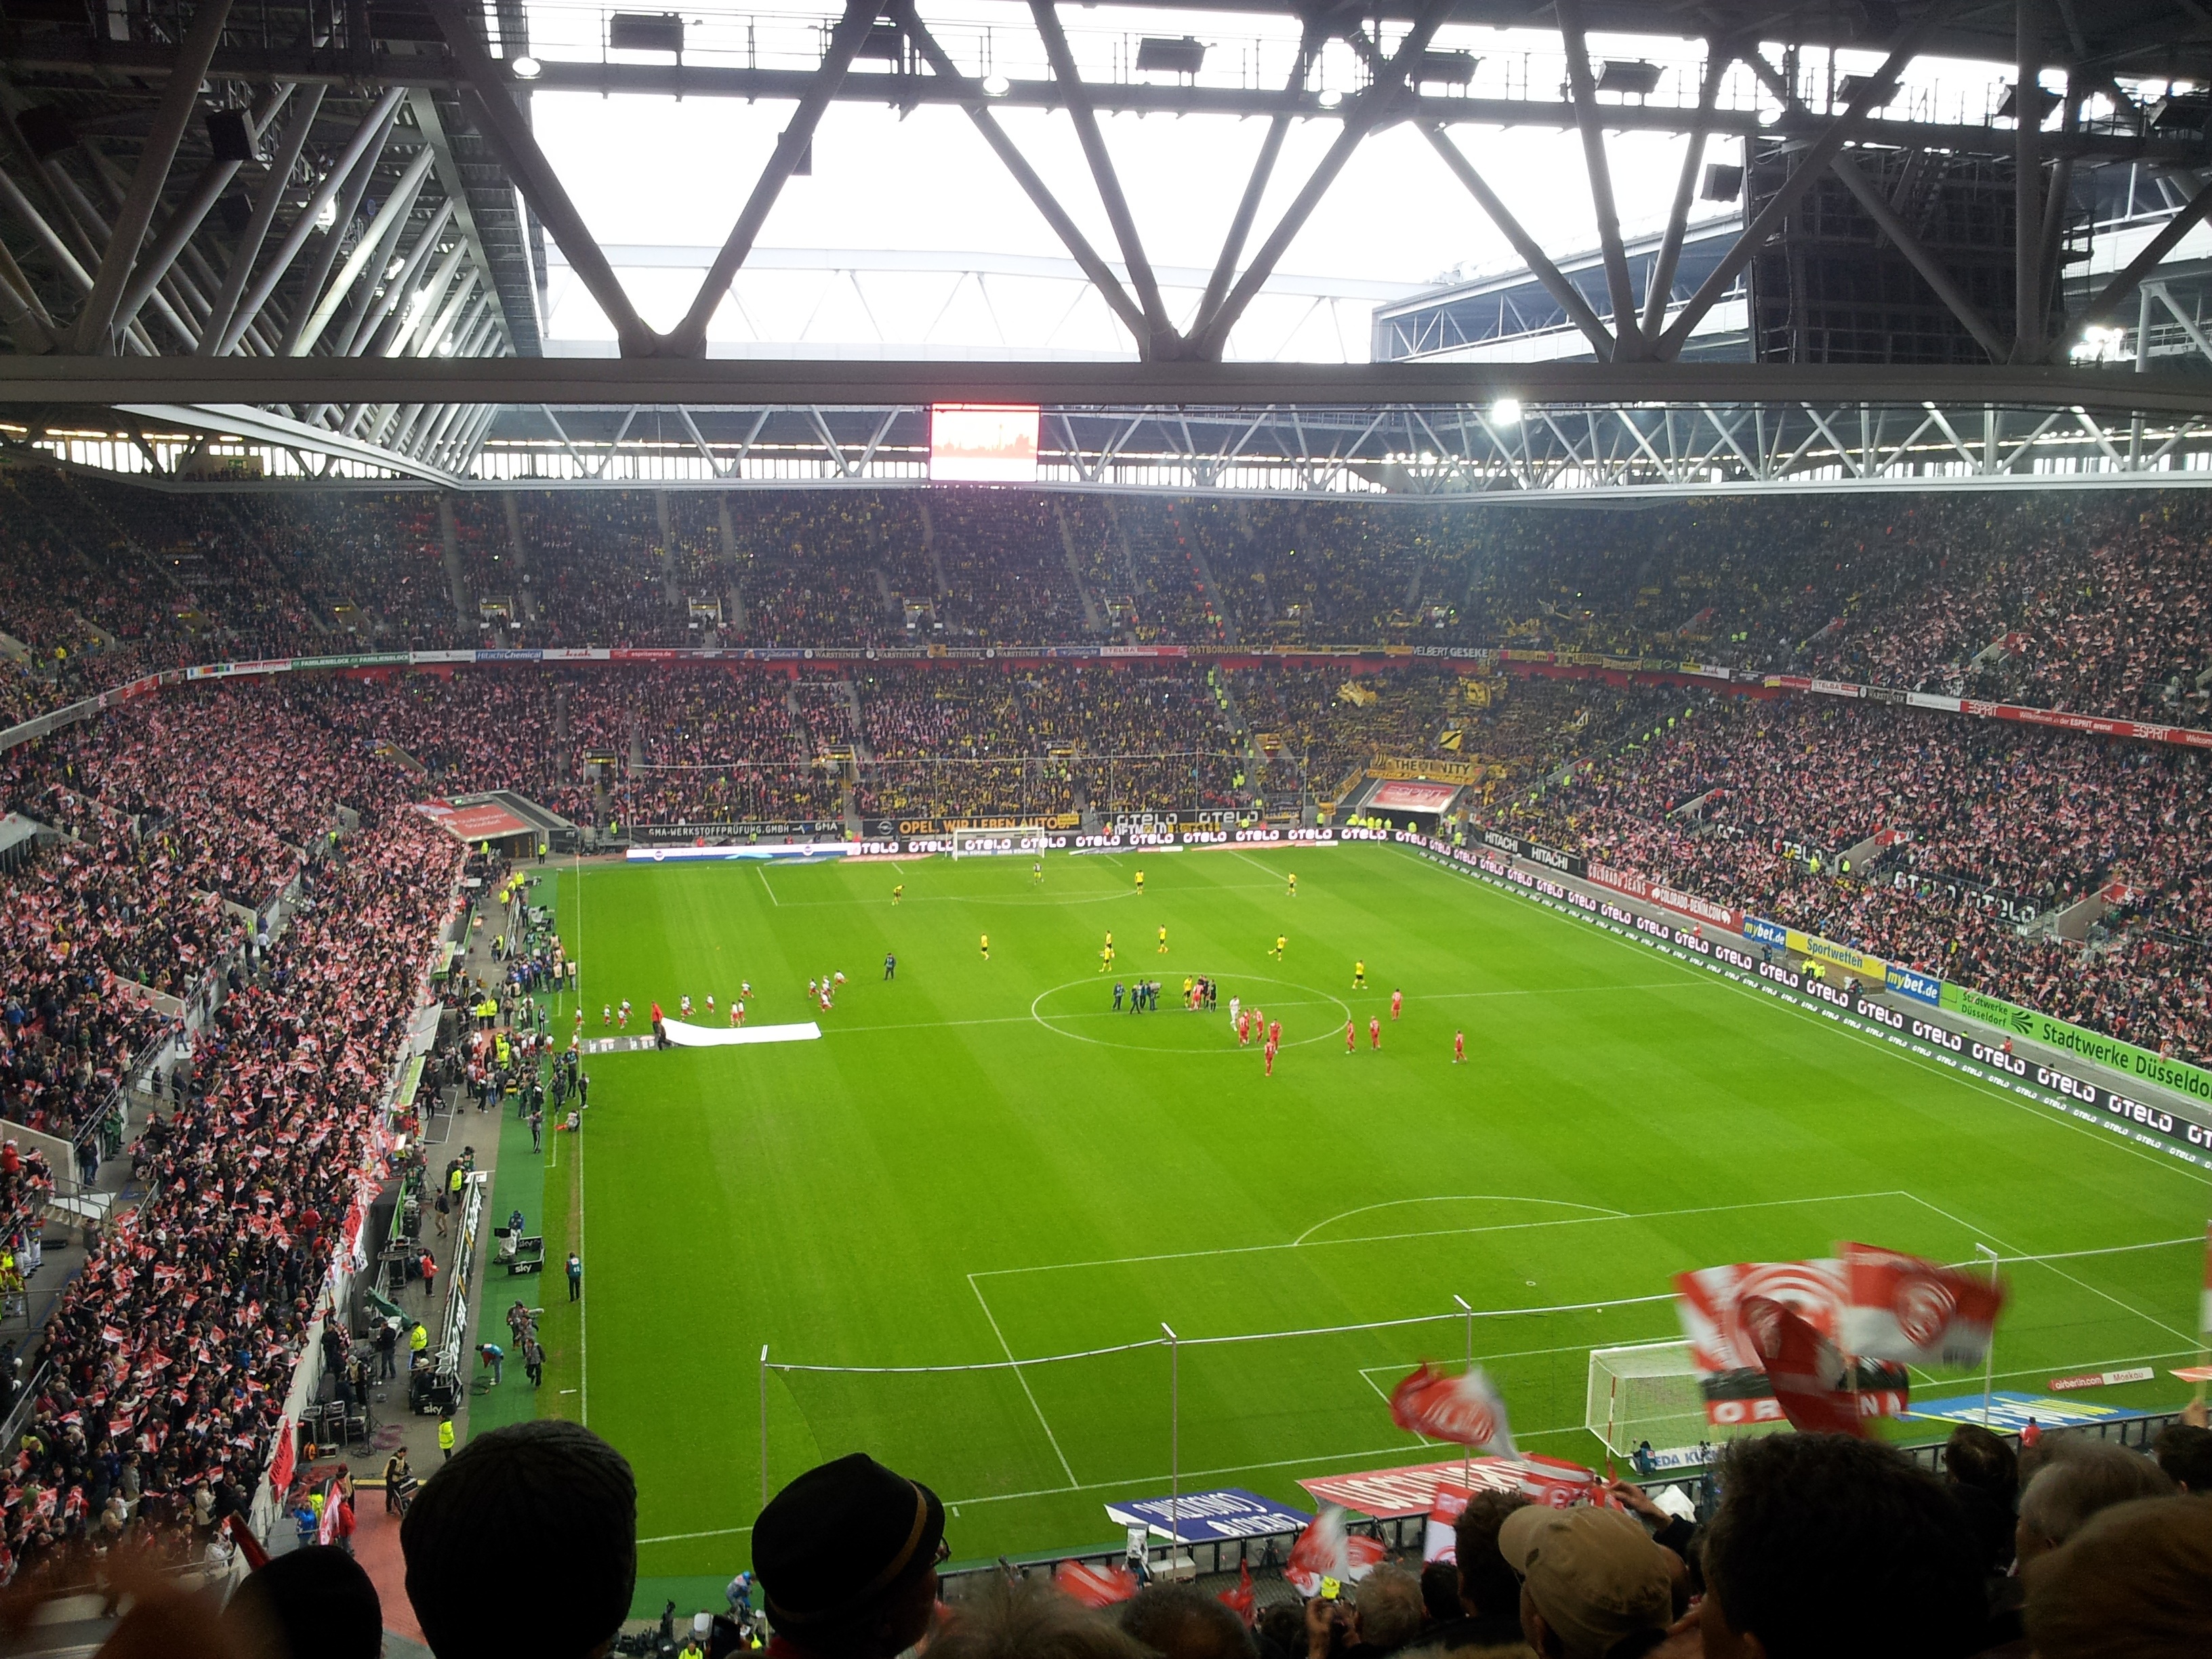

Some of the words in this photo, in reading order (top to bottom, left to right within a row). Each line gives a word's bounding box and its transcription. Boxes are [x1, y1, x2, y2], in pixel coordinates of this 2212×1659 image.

[1189, 645, 1250, 654] OSTBORUSSEN
[1450, 647, 1488, 657] GESEKE
[301, 659, 349, 667] FAMILIENBLOCK
[359, 655, 409, 663] FAMILIENBLOCK
[1968, 702, 1999, 717] ESPRIT
[2070, 719, 2092, 729] ESPRIT
[2133, 724, 2171, 741] ESPRIT
[815, 822, 838, 832] GMA
[900, 819, 940, 834] OPEL.
[943, 819, 969, 832] WIR
[1485, 831, 1518, 853] HITACHI
[1532, 846, 1568, 870] HITACHI
[1589, 864, 1622, 888] COLORADO
[1624, 877, 1647, 896] JEANS
[1744, 920, 1785, 945] mybet.de
[1807, 939, 1863, 969] Sportwetten
[1887, 970, 1938, 1000] mybet.de
[1963, 992, 2008, 1015] Stadtwerke
[1961, 1004, 2007, 1027] Düsseldorf
[2043, 1023, 2129, 1069] Stadtwerke
[2135, 1054, 2212, 1100] Düsseldo
[515, 1263, 533, 1273] sky
[2055, 1376, 2102, 1389] airberlin.com
[2113, 1372, 2145, 1382] Moskau
[423, 1403, 443, 1415] sky
[1654, 1454, 1681, 1467] EDA
